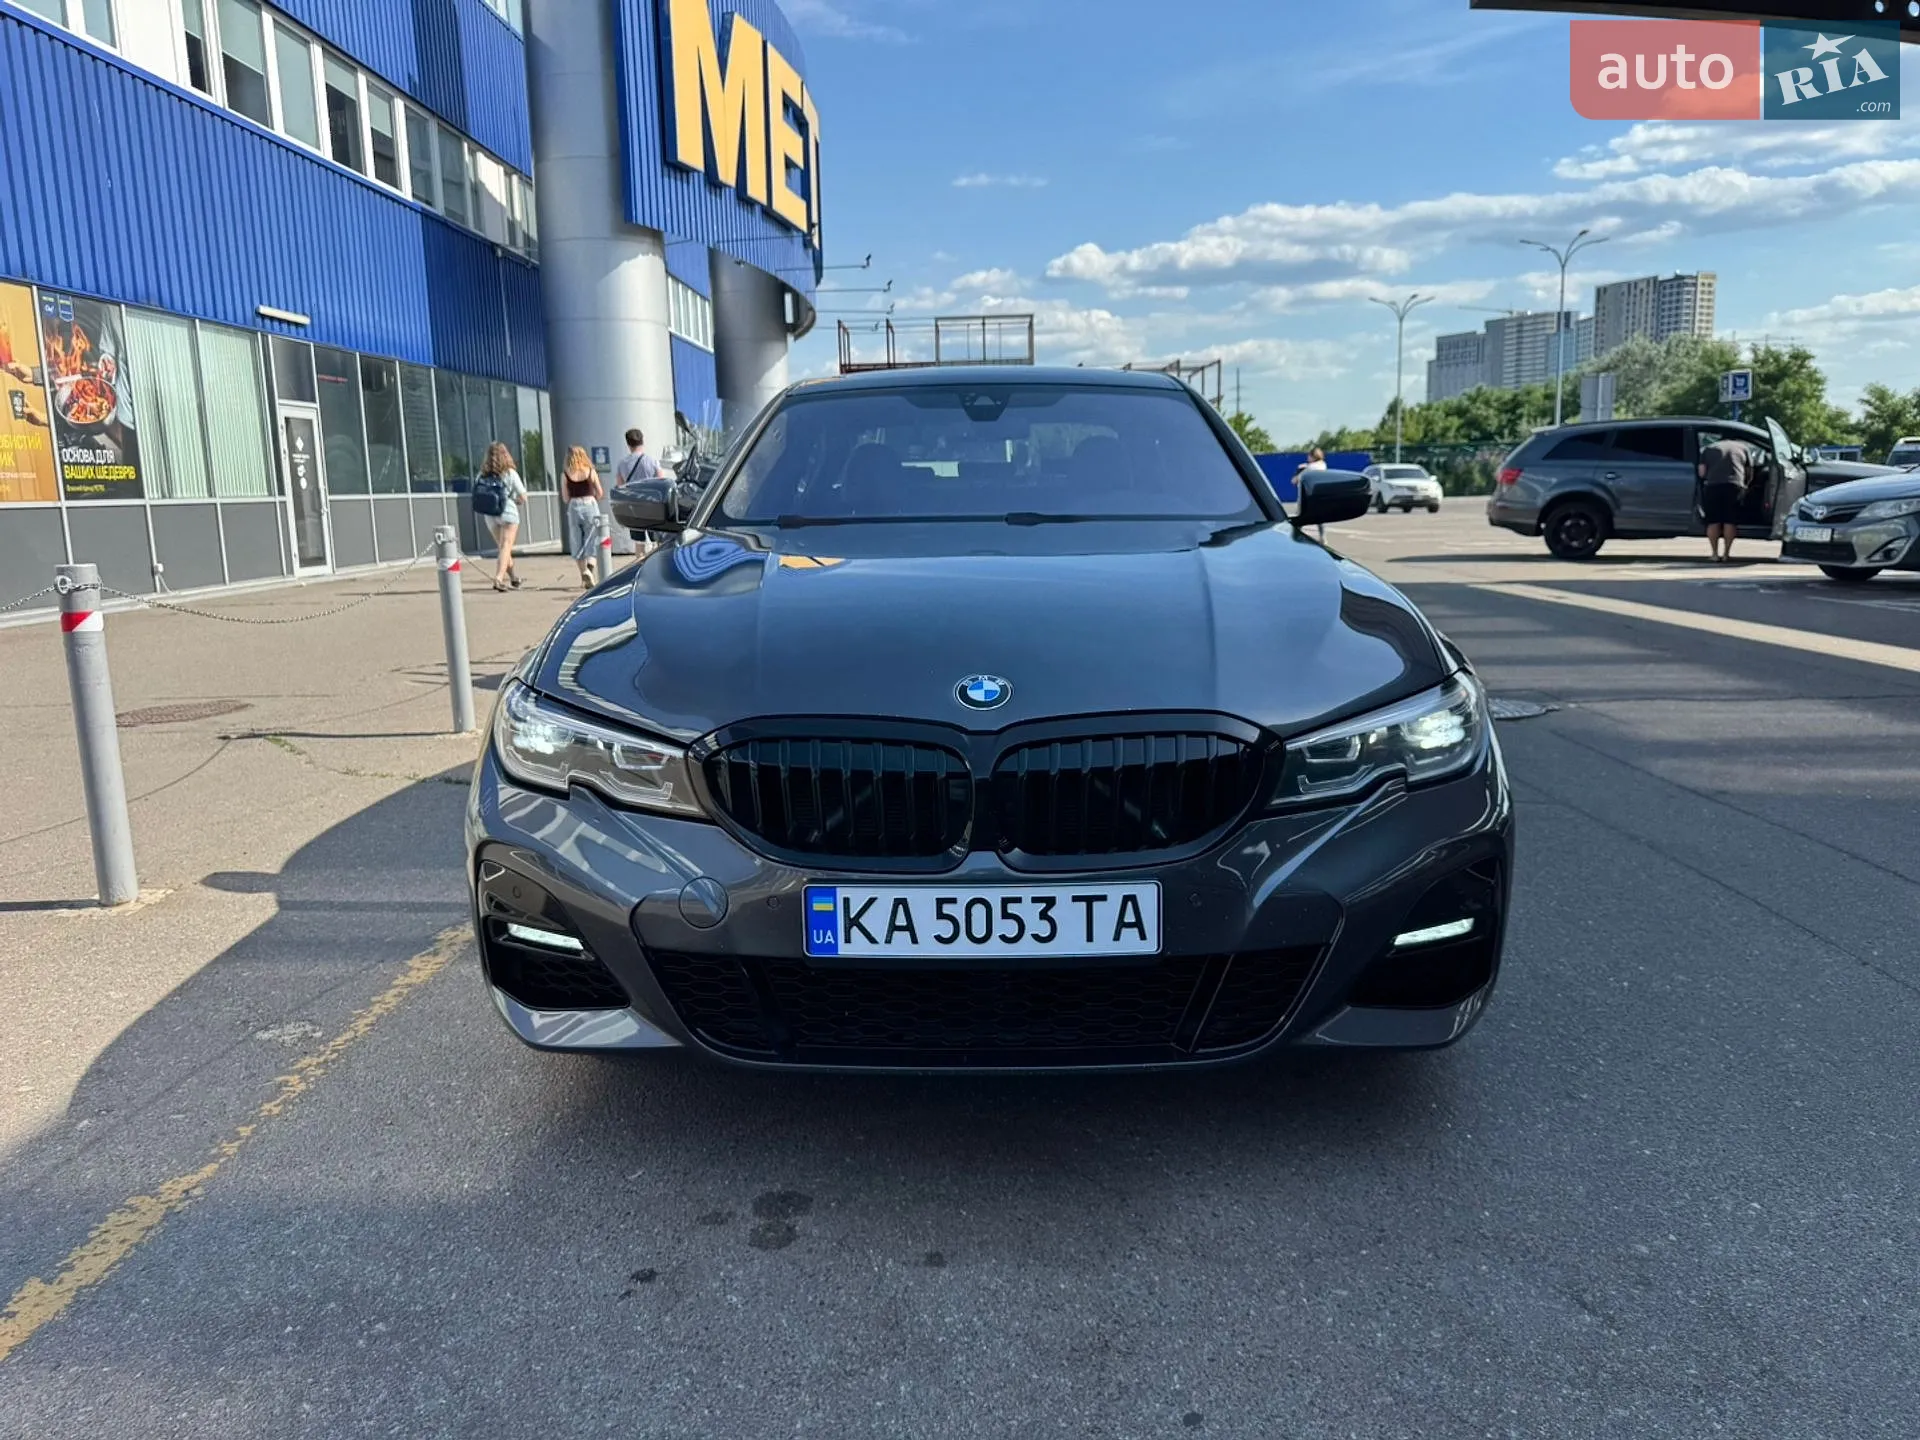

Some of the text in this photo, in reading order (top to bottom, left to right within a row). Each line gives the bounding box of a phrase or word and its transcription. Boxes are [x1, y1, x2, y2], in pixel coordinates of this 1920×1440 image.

[62, 448, 115, 464] ОСНОВА ДЛЯ
[842, 894, 1148, 945] KA 5053 TA
[813, 929, 836, 944] UA
